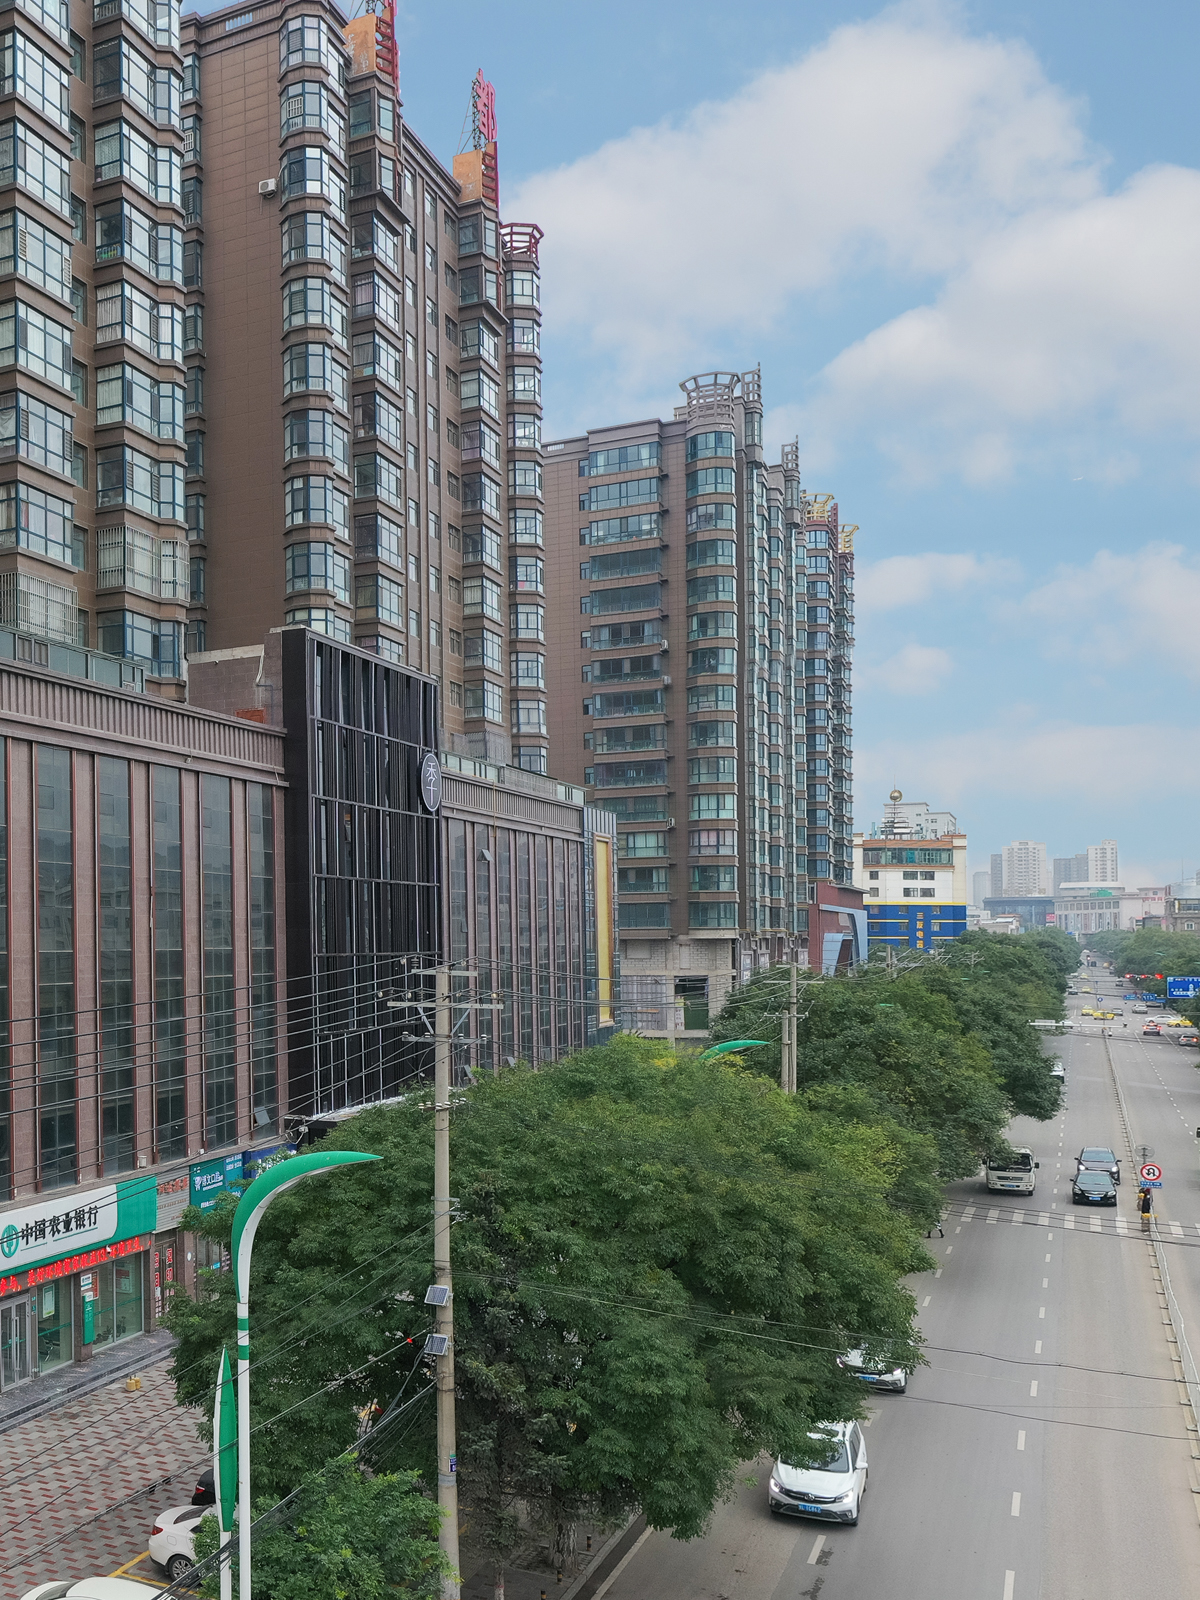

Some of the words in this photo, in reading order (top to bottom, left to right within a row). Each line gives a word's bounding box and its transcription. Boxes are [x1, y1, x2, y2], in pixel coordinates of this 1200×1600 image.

[425, 762, 438, 806] 季
[21, 1205, 99, 1247] 中国农业银行
